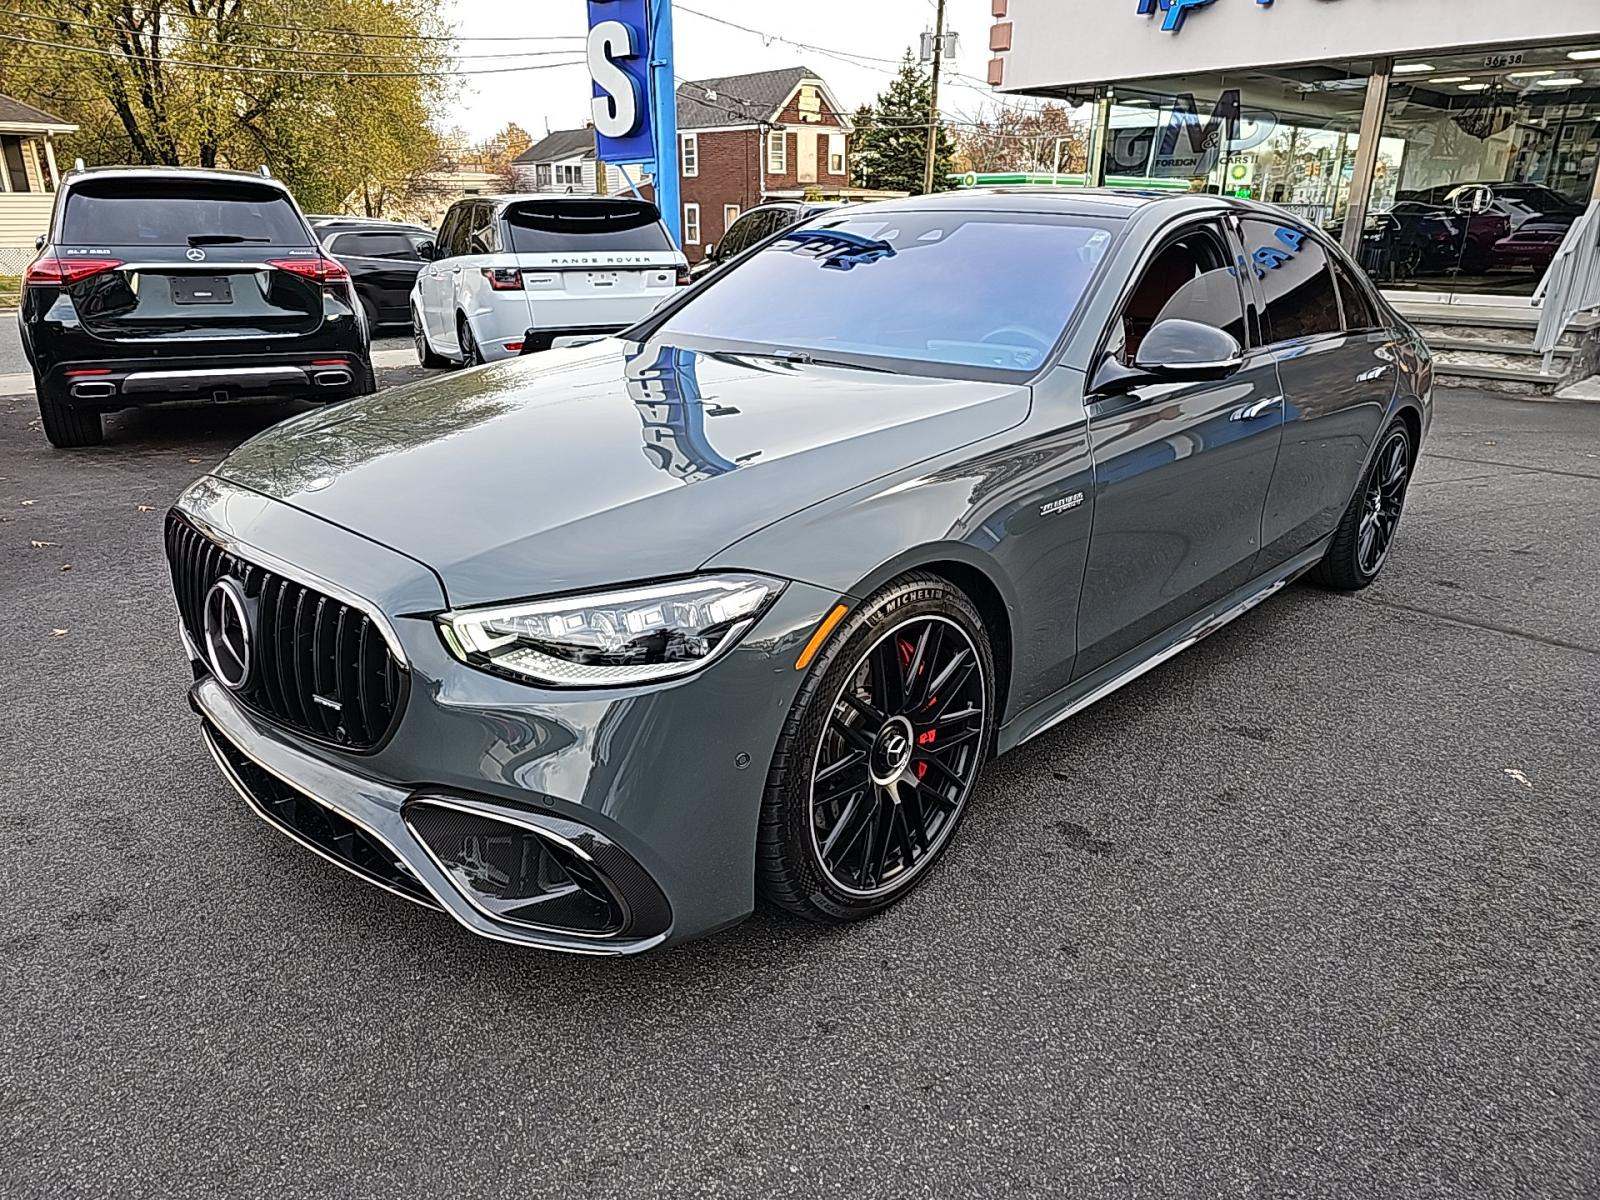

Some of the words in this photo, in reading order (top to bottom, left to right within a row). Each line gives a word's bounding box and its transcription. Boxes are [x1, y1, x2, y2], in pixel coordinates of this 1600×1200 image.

[1485, 55, 1522, 67] 36-38
[1156, 158, 1198, 168] FOREIGN
[1219, 155, 1249, 165] CARS
[886, 590, 943, 614] MICHELIN
